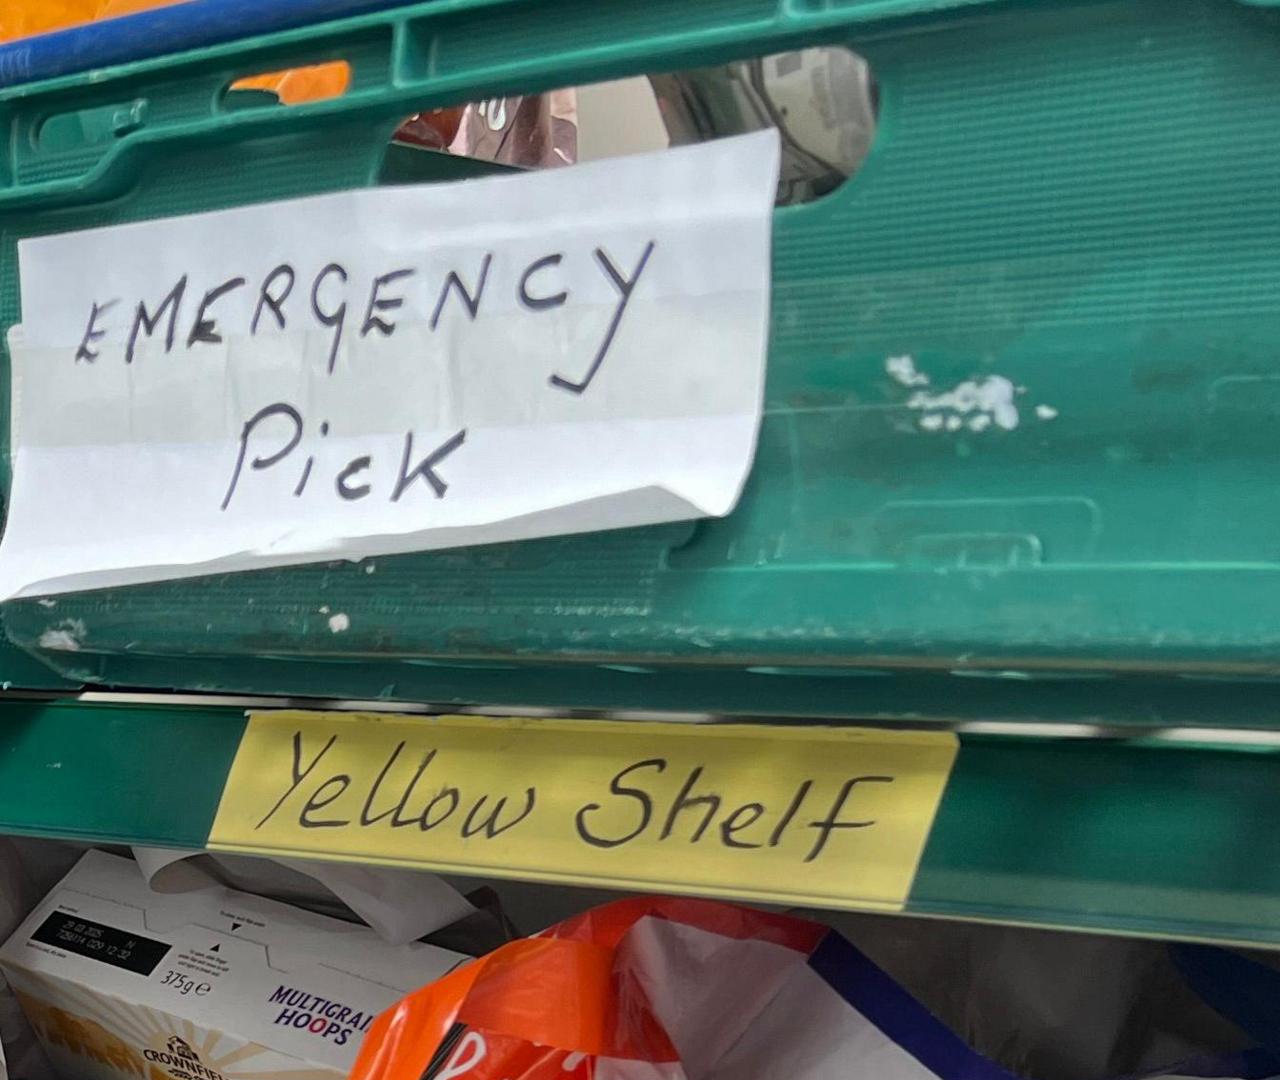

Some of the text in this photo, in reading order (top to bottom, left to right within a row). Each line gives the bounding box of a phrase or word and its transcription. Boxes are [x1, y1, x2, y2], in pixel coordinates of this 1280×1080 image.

[73, 239, 656, 394] EMERGENCY
[255, 731, 894, 863] Yellow Shelf
[160, 970, 194, 995] 375g
[274, 1007, 356, 1047] HOOPS
